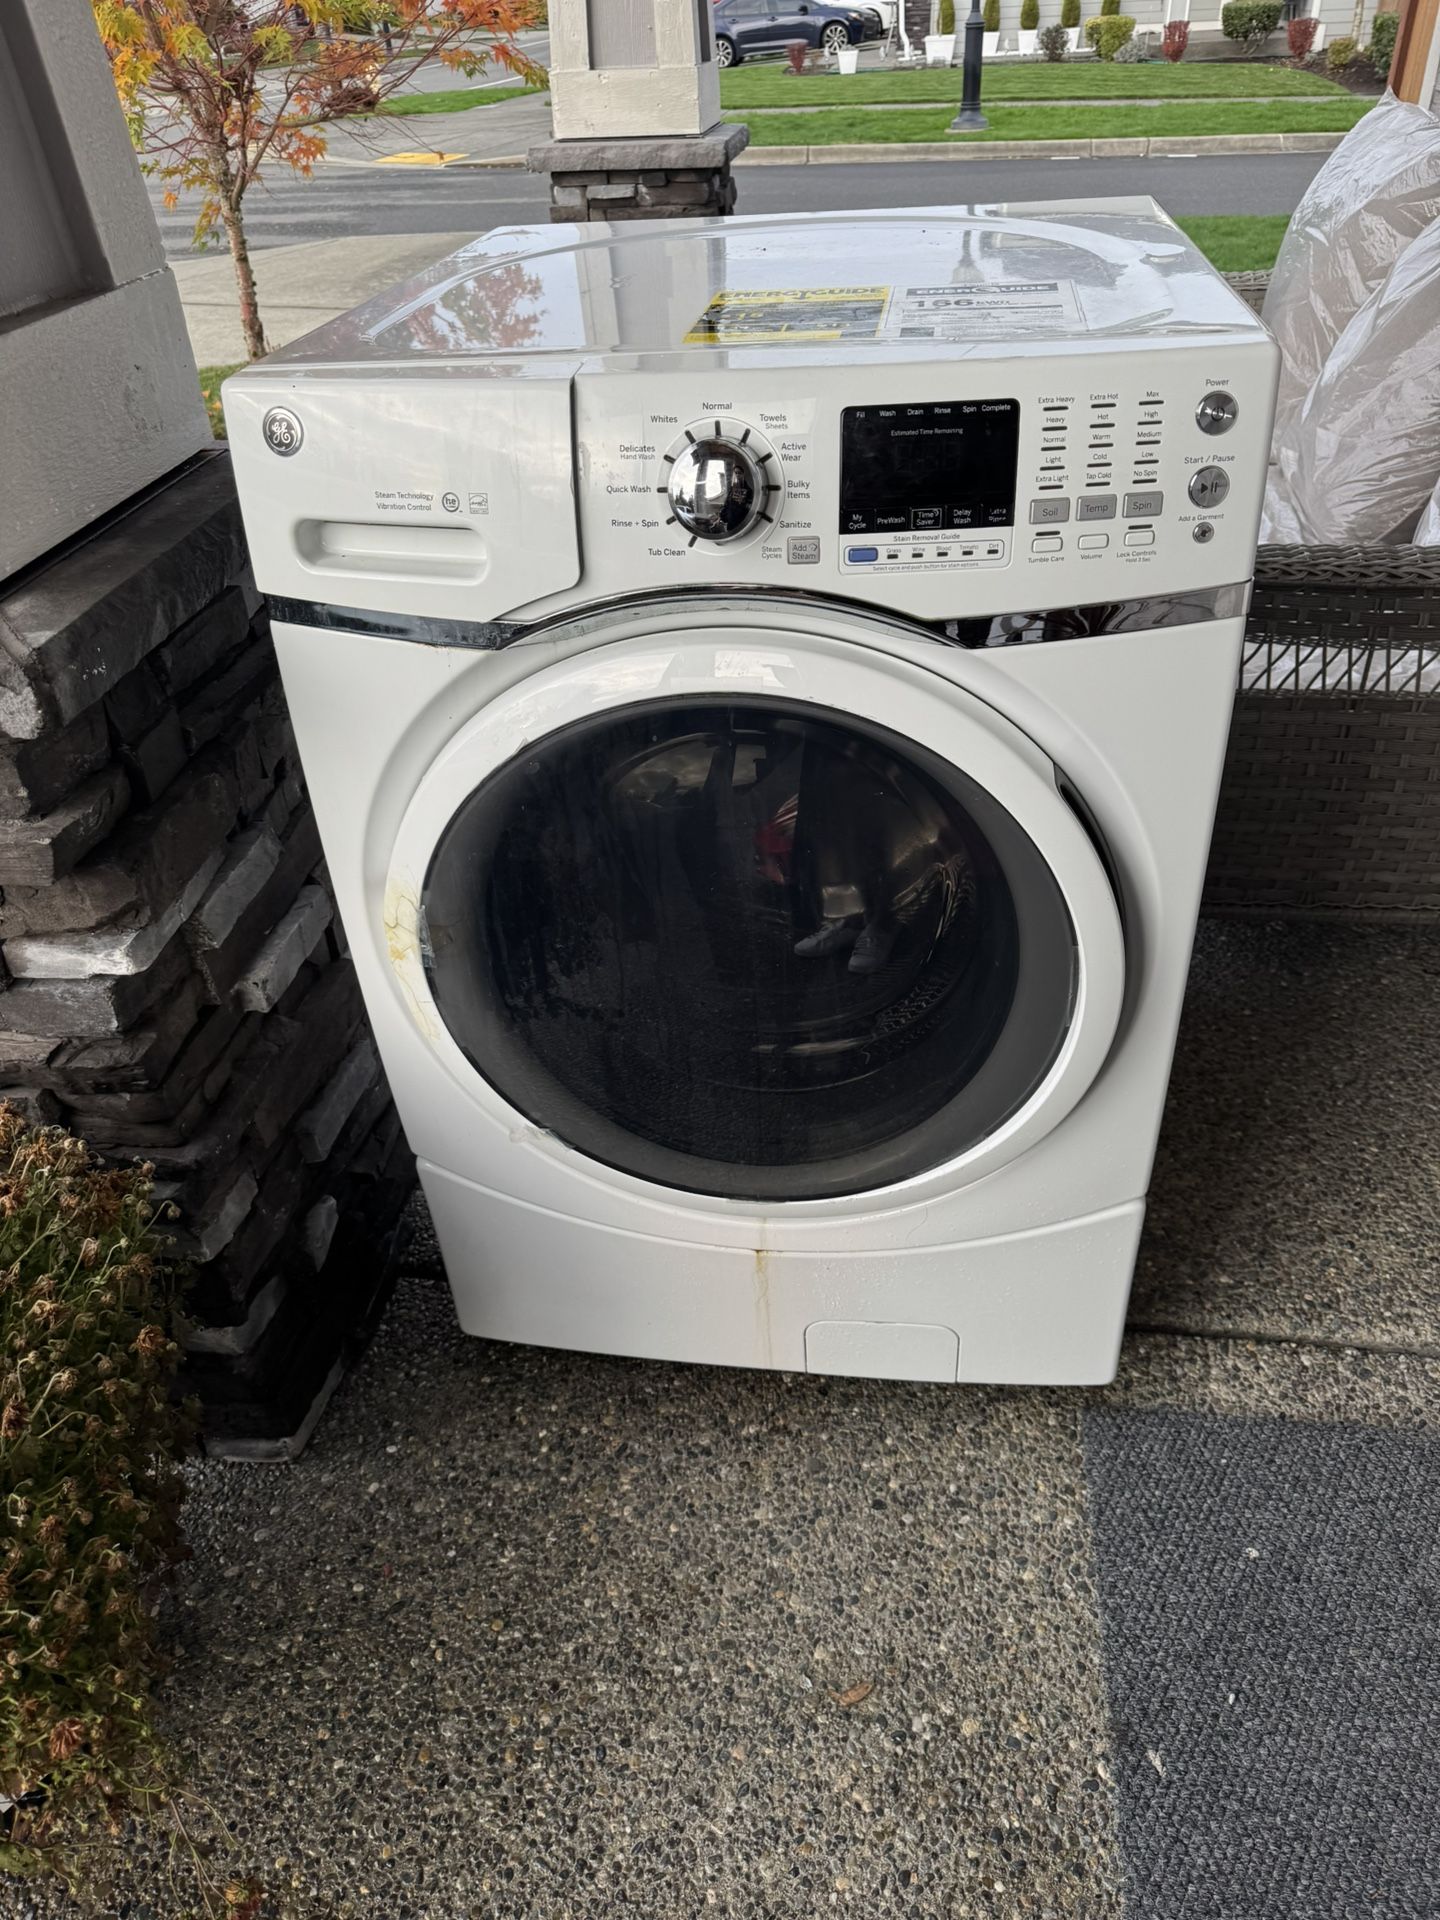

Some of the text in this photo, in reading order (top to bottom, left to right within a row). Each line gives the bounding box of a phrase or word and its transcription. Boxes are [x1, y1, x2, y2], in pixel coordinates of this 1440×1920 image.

[1205, 379, 1230, 387] Power
[702, 402, 732, 410] Normal
[962, 405, 977, 413] Spin
[981, 404, 1011, 413] Complete
[879, 409, 896, 417] Wash
[907, 408, 924, 416] Drain
[650, 415, 678, 423] Whites
[760, 414, 786, 422] Towels
[890, 429, 919, 437] Estimated
[934, 427, 963, 435] Remaining
[619, 444, 655, 452] Delicates
[1046, 456, 1061, 464] Light
[1184, 456, 1204, 465] Start
[1206, 455, 1210, 463] /
[1143, 469, 1157, 477] Spin
[787, 480, 810, 489] Bulky
[606, 485, 651, 493] Quick Wash
[375, 491, 434, 501] Steam Technology
[445, 497, 457, 506] he
[1132, 501, 1152, 510] Spin
[376, 502, 432, 511] Vibration Control
[1085, 504, 1108, 513] Temp
[953, 509, 972, 517] Delay
[1042, 508, 1058, 517] Soil
[852, 513, 863, 522] My
[876, 516, 906, 524] PreWash
[953, 516, 971, 524] Wash
[1197, 513, 1224, 521] Garment
[611, 519, 633, 527] Rinse
[641, 519, 659, 528] Spin
[848, 522, 867, 530] Cycle
[916, 518, 935, 526] Saver
[893, 532, 960, 542] Stain Removal Guide
[648, 548, 686, 556] Tub Clean
[792, 552, 816, 560] Steam
[1028, 556, 1049, 564] Tumble
